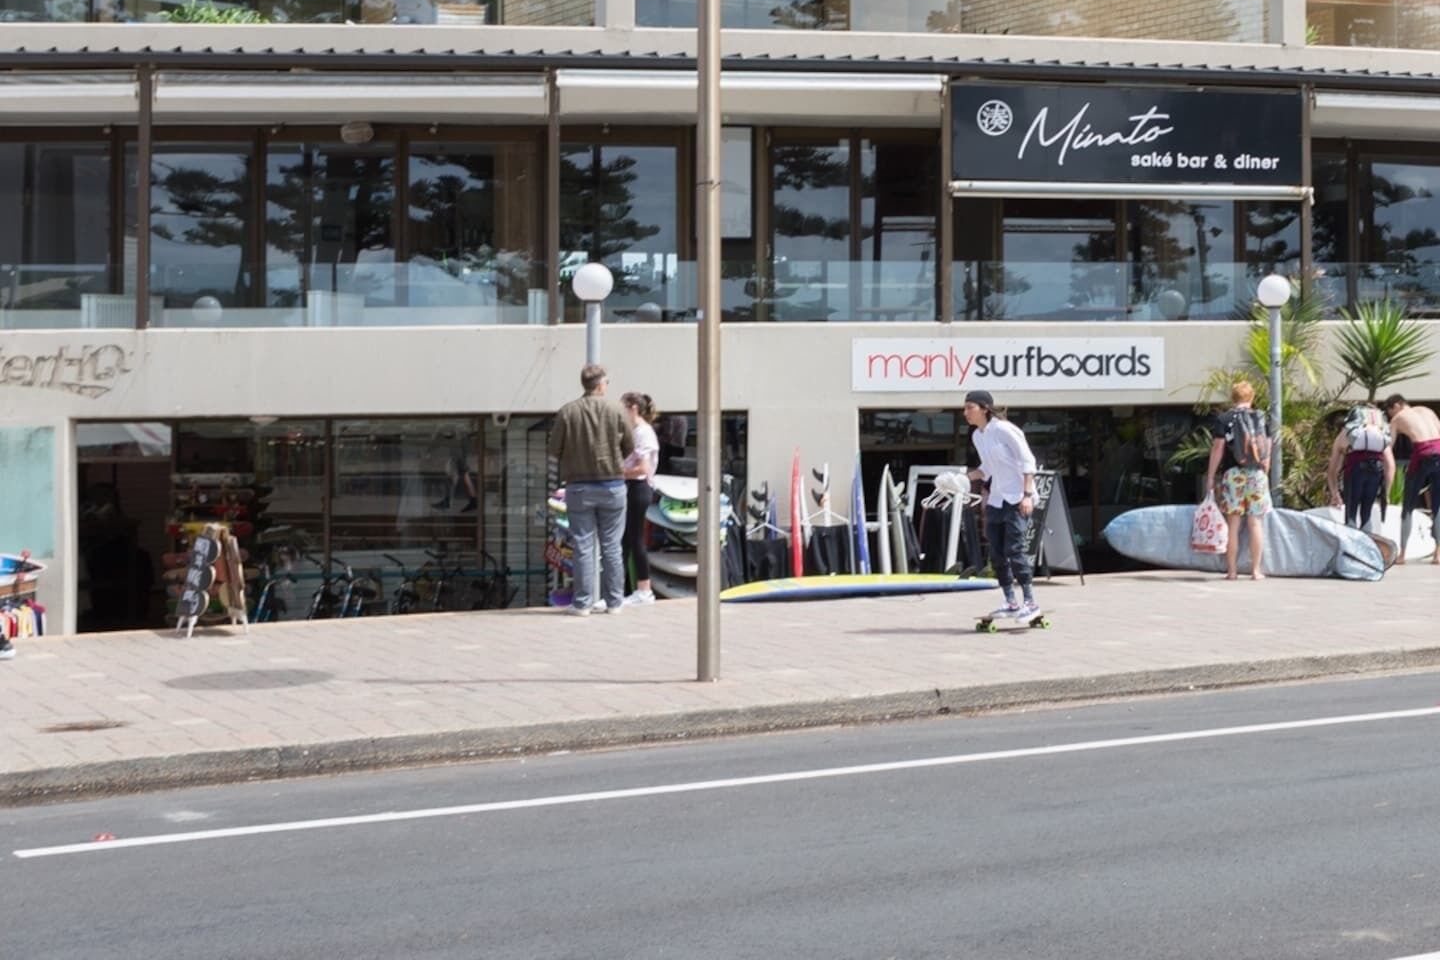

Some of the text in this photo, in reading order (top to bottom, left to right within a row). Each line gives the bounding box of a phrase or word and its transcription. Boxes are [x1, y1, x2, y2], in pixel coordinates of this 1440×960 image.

[1018, 102, 1174, 166] Minato
[1131, 151, 1279, 170] saké bar & diner
